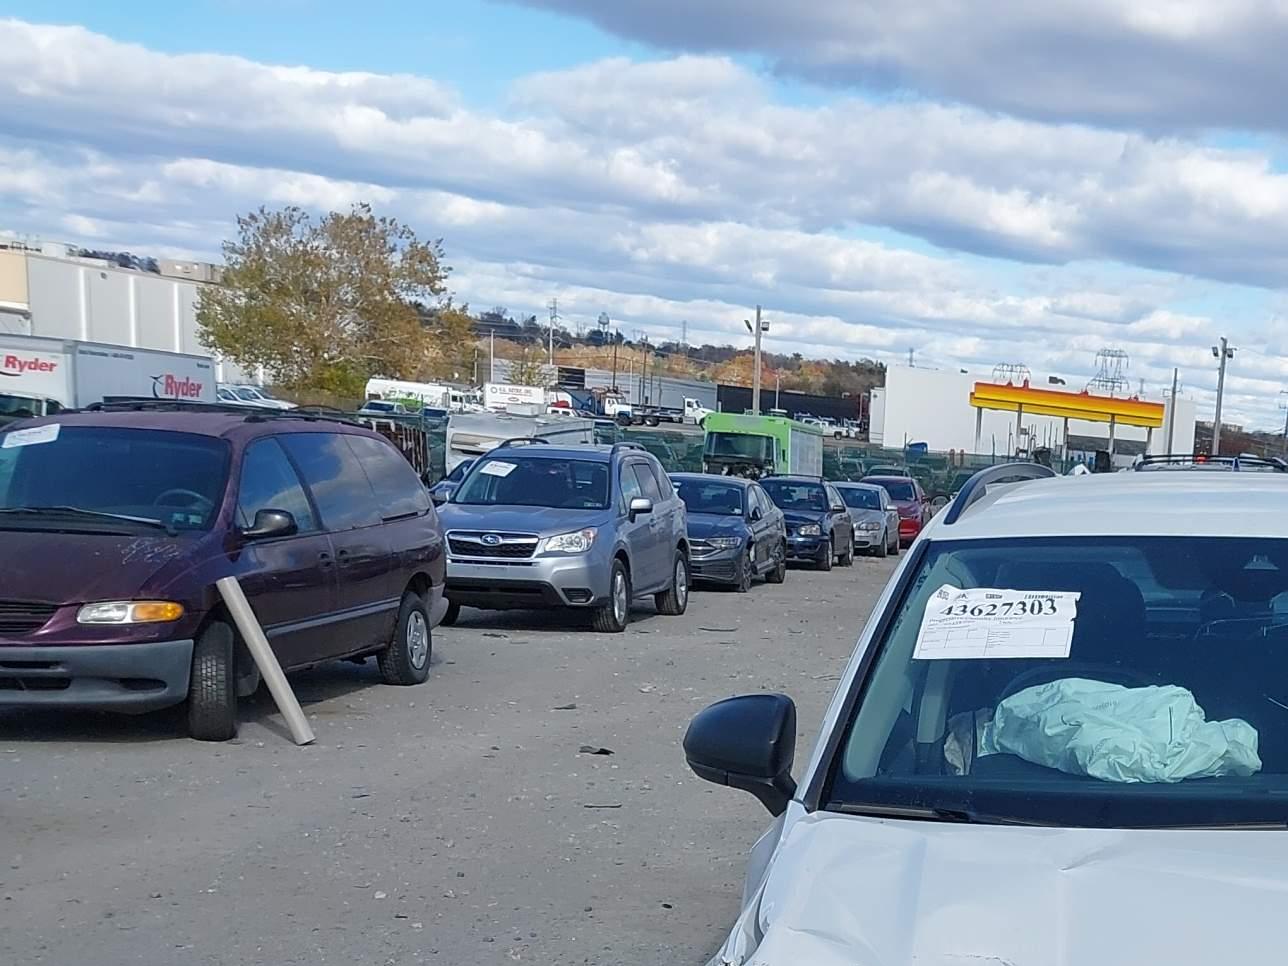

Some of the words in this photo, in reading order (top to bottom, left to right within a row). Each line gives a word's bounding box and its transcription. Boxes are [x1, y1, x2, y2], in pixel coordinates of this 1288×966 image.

[4, 355, 57, 372] Ryder
[164, 374, 203, 398] Ryder
[939, 599, 1057, 617] 43627303
